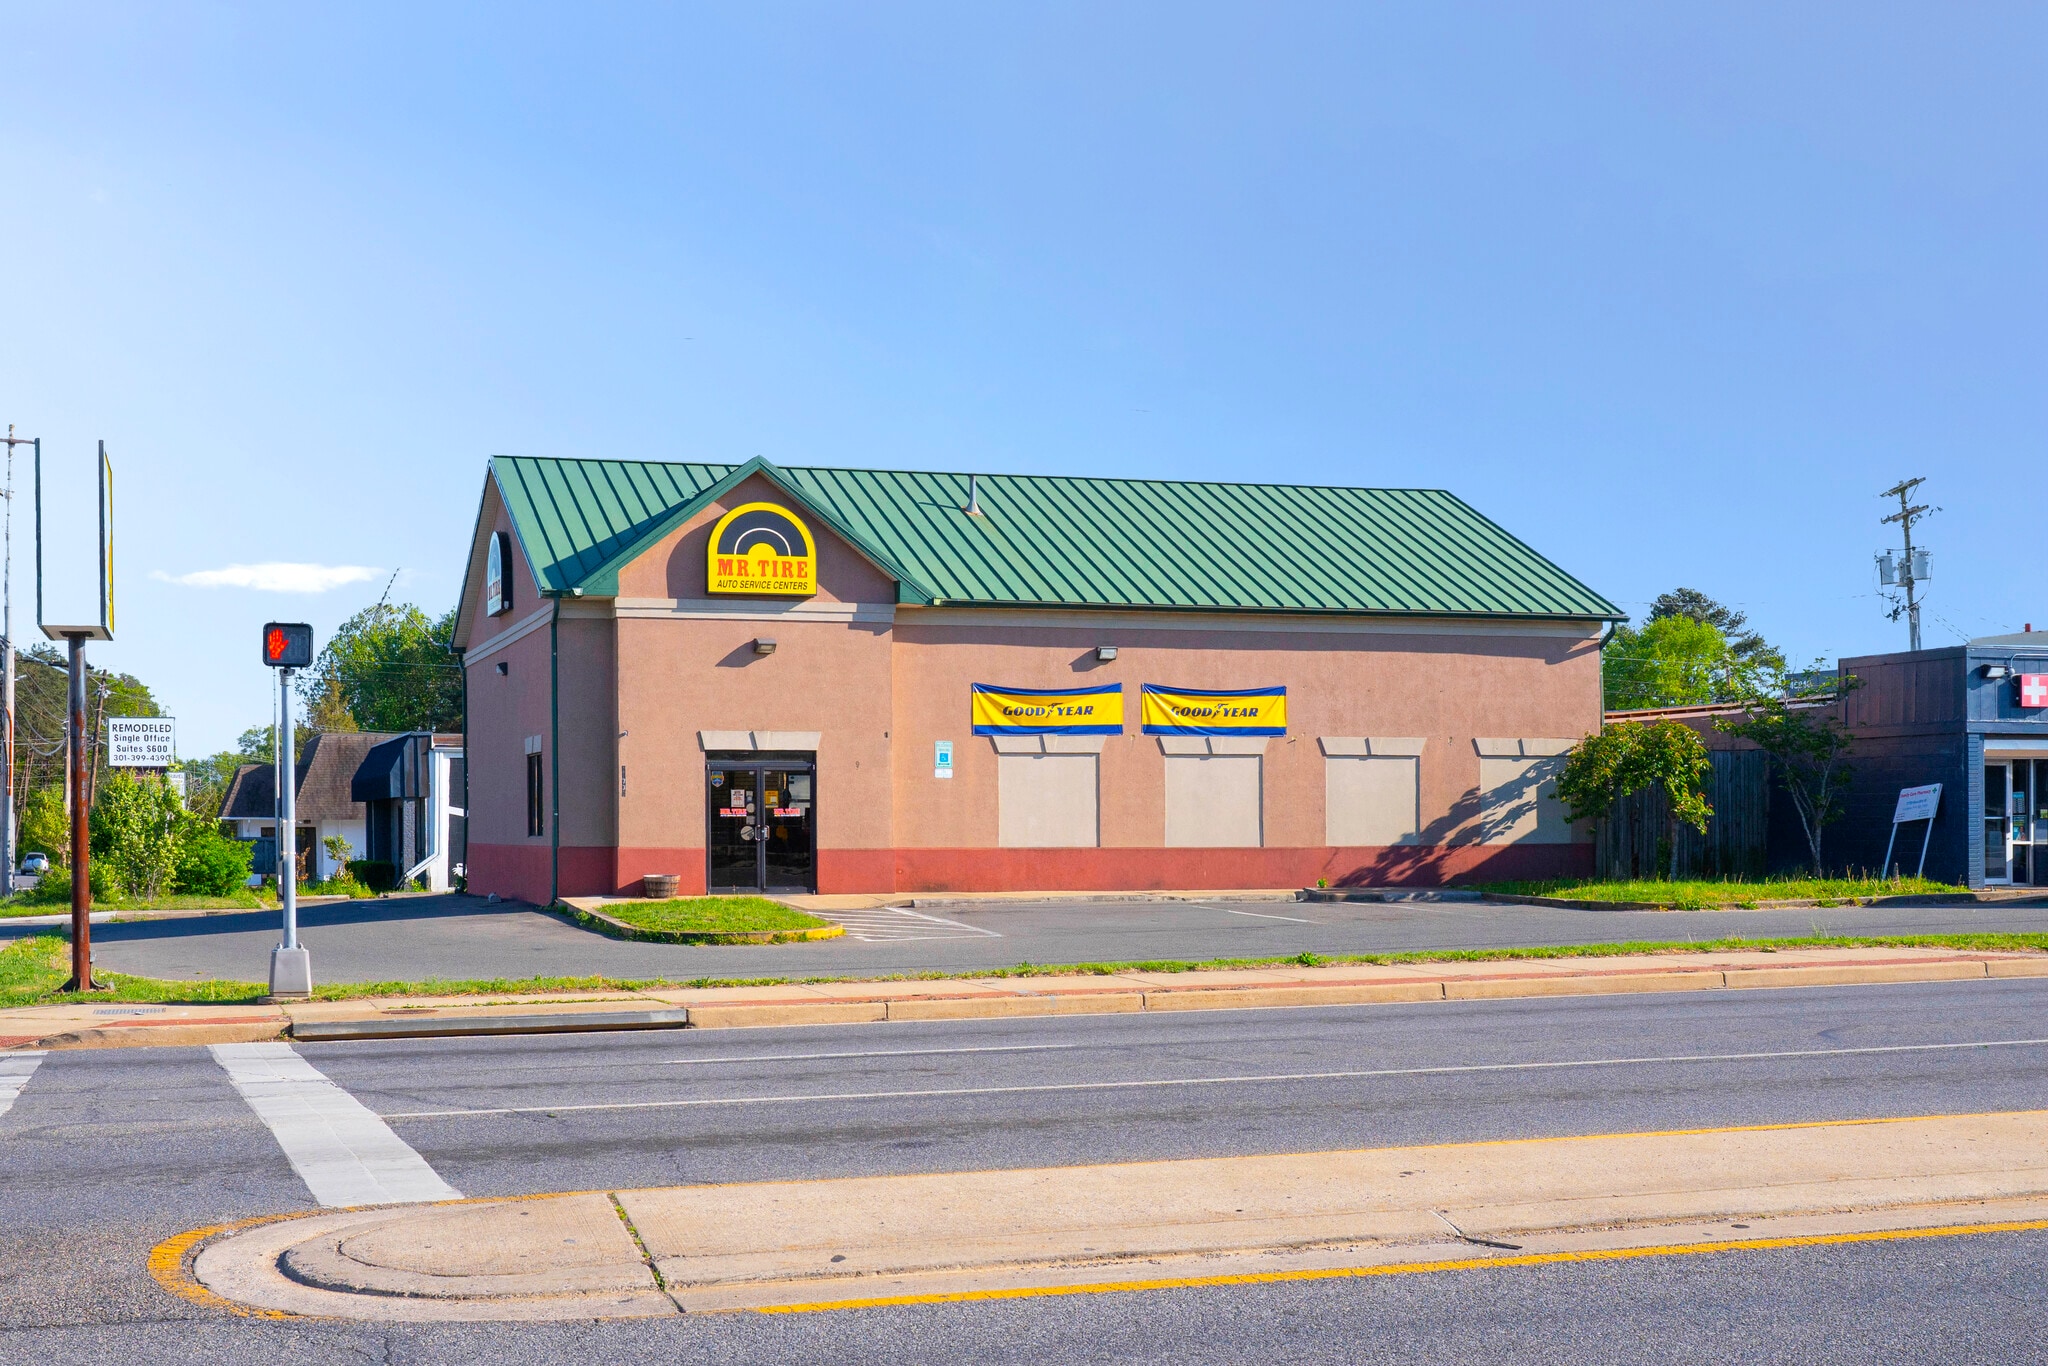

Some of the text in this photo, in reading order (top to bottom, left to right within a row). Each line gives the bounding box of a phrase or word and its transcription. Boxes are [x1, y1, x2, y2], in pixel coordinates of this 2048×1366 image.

[717, 580, 808, 590] AUTO SERVICE CENTERS
[112, 724, 172, 732] REMODELED
[114, 734, 170, 743] Single Office
[146, 745, 168, 753] $600
